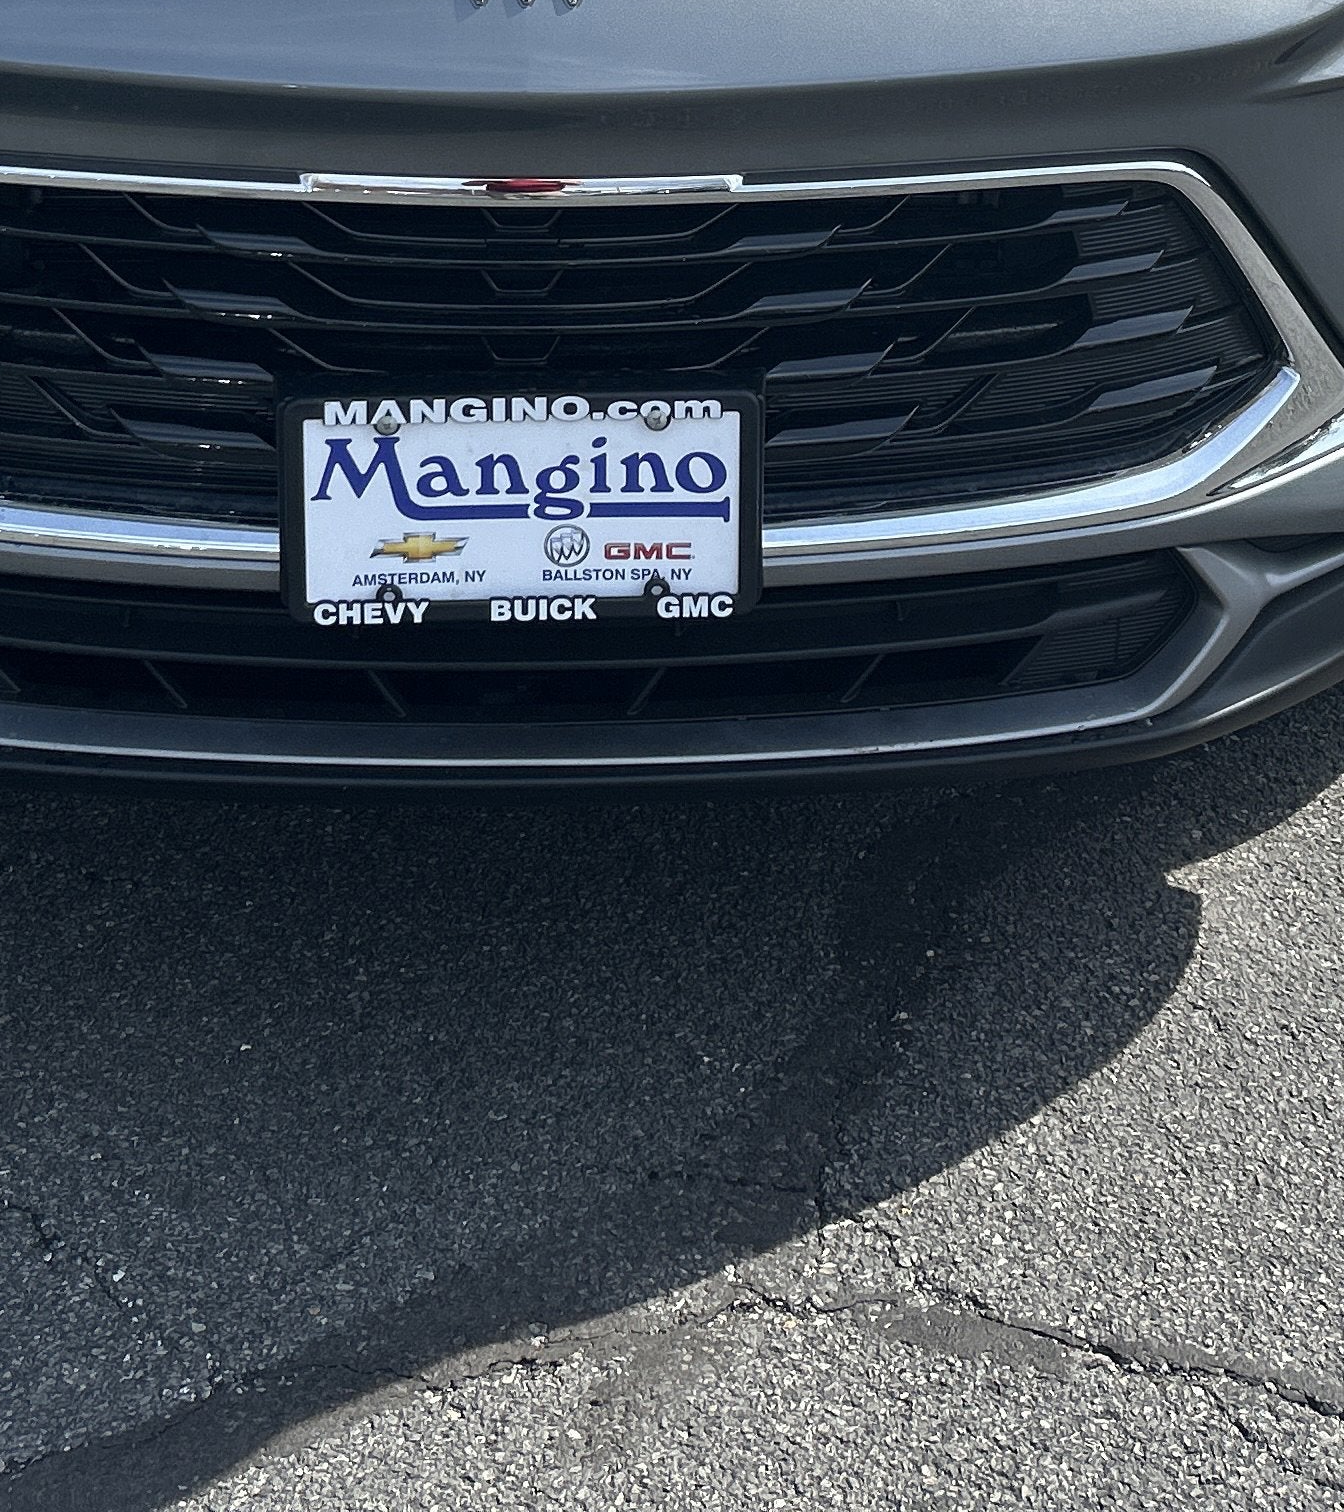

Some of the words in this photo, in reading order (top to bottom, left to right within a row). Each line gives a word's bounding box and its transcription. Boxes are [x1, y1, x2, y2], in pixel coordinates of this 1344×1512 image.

[324, 395, 722, 426] MANGINO.com
[310, 436, 730, 522] Mangino
[604, 542, 692, 561] GMC
[352, 571, 460, 587] AMSTERDAM,
[464, 569, 487, 583] NY
[542, 568, 626, 581] BALLSTON
[670, 568, 693, 581] NY
[313, 600, 430, 626] CHEVY
[490, 597, 597, 622] BUICK
[657, 594, 734, 619] GMC
